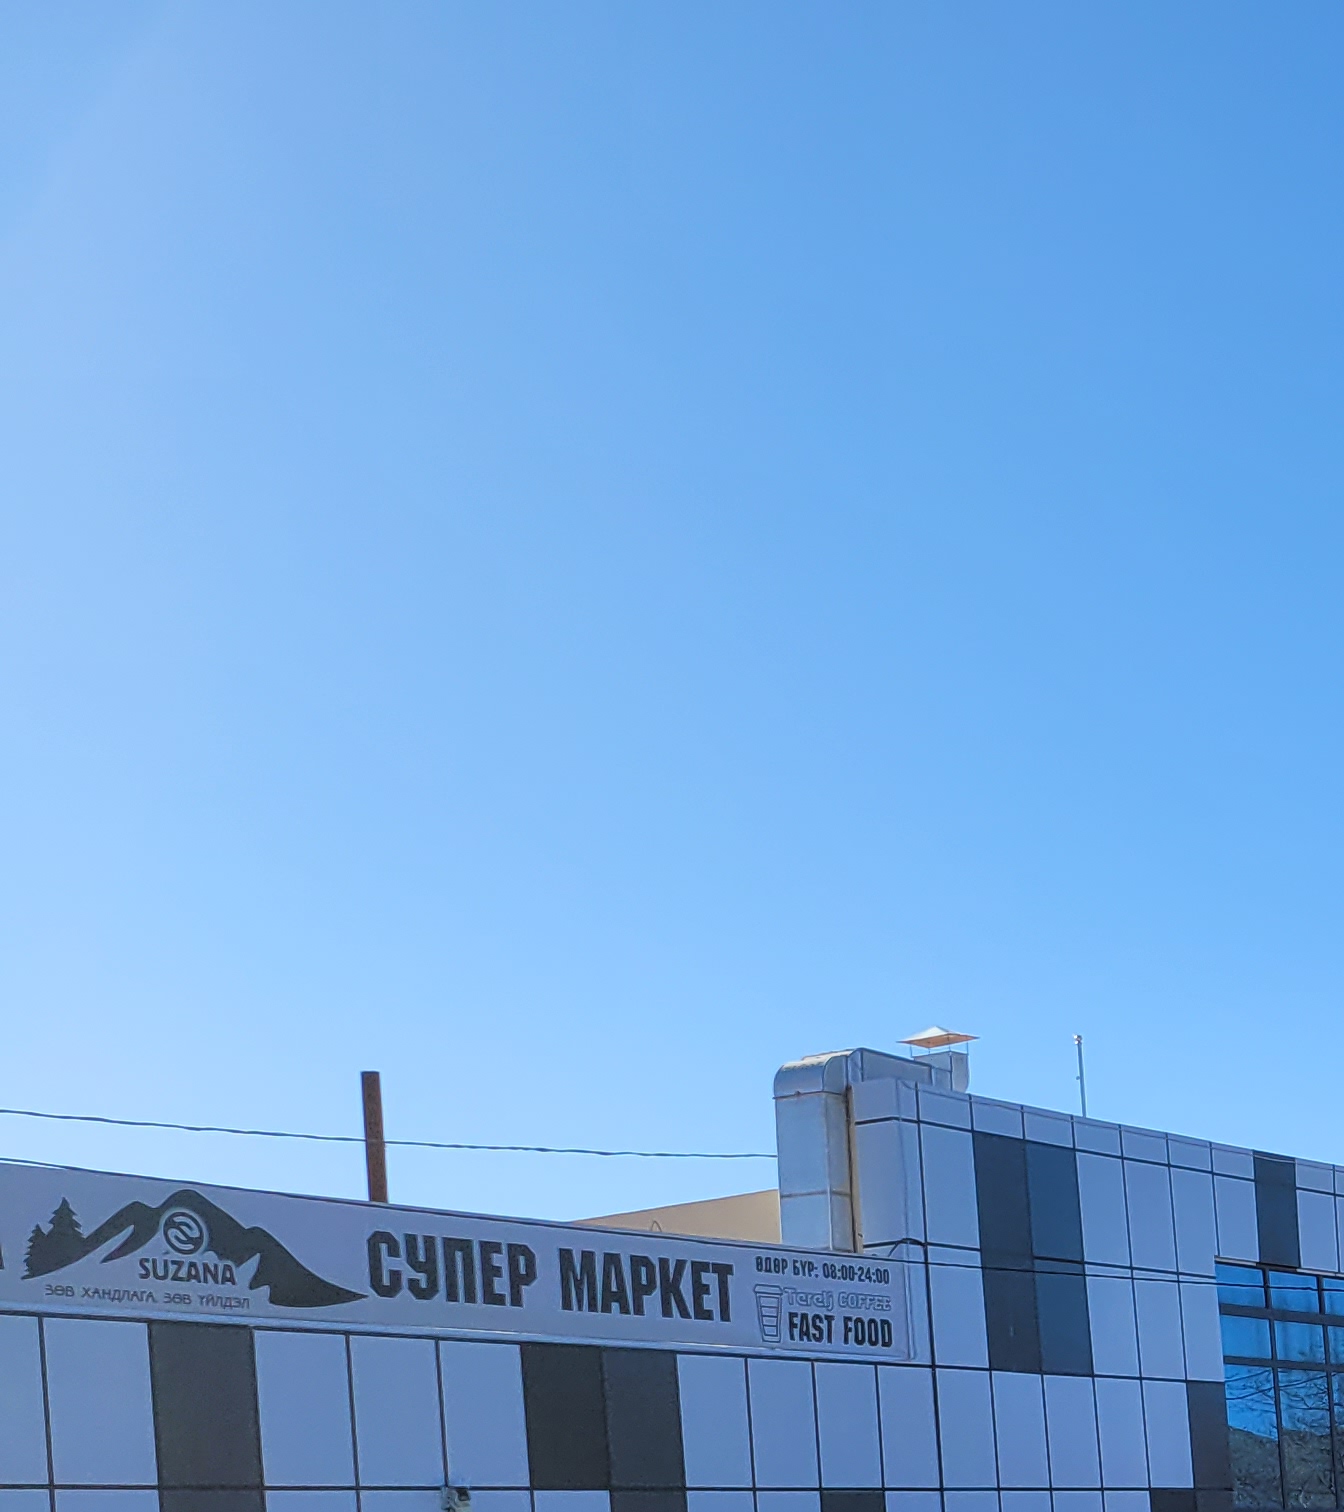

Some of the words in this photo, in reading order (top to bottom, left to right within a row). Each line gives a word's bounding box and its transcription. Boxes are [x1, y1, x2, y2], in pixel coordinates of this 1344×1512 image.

[138, 1257, 237, 1285] SUZANA
[366, 1230, 536, 1307] СУПЕР
[558, 1247, 734, 1322] МАРКЕТ
[754, 1255, 788, 1274] ӨДӨР
[792, 1258, 818, 1278] БҮР:
[822, 1262, 889, 1284] 08:00-24:00
[44, 1284, 74, 1297] ЗӨВ
[80, 1286, 154, 1302] ХАНДЛАГА
[163, 1292, 191, 1304] ЗӨВ
[783, 1286, 833, 1311] Terelj
[838, 1291, 891, 1310] COFFEE
[788, 1311, 834, 1344] FAST
[843, 1315, 892, 1347] FOOD
